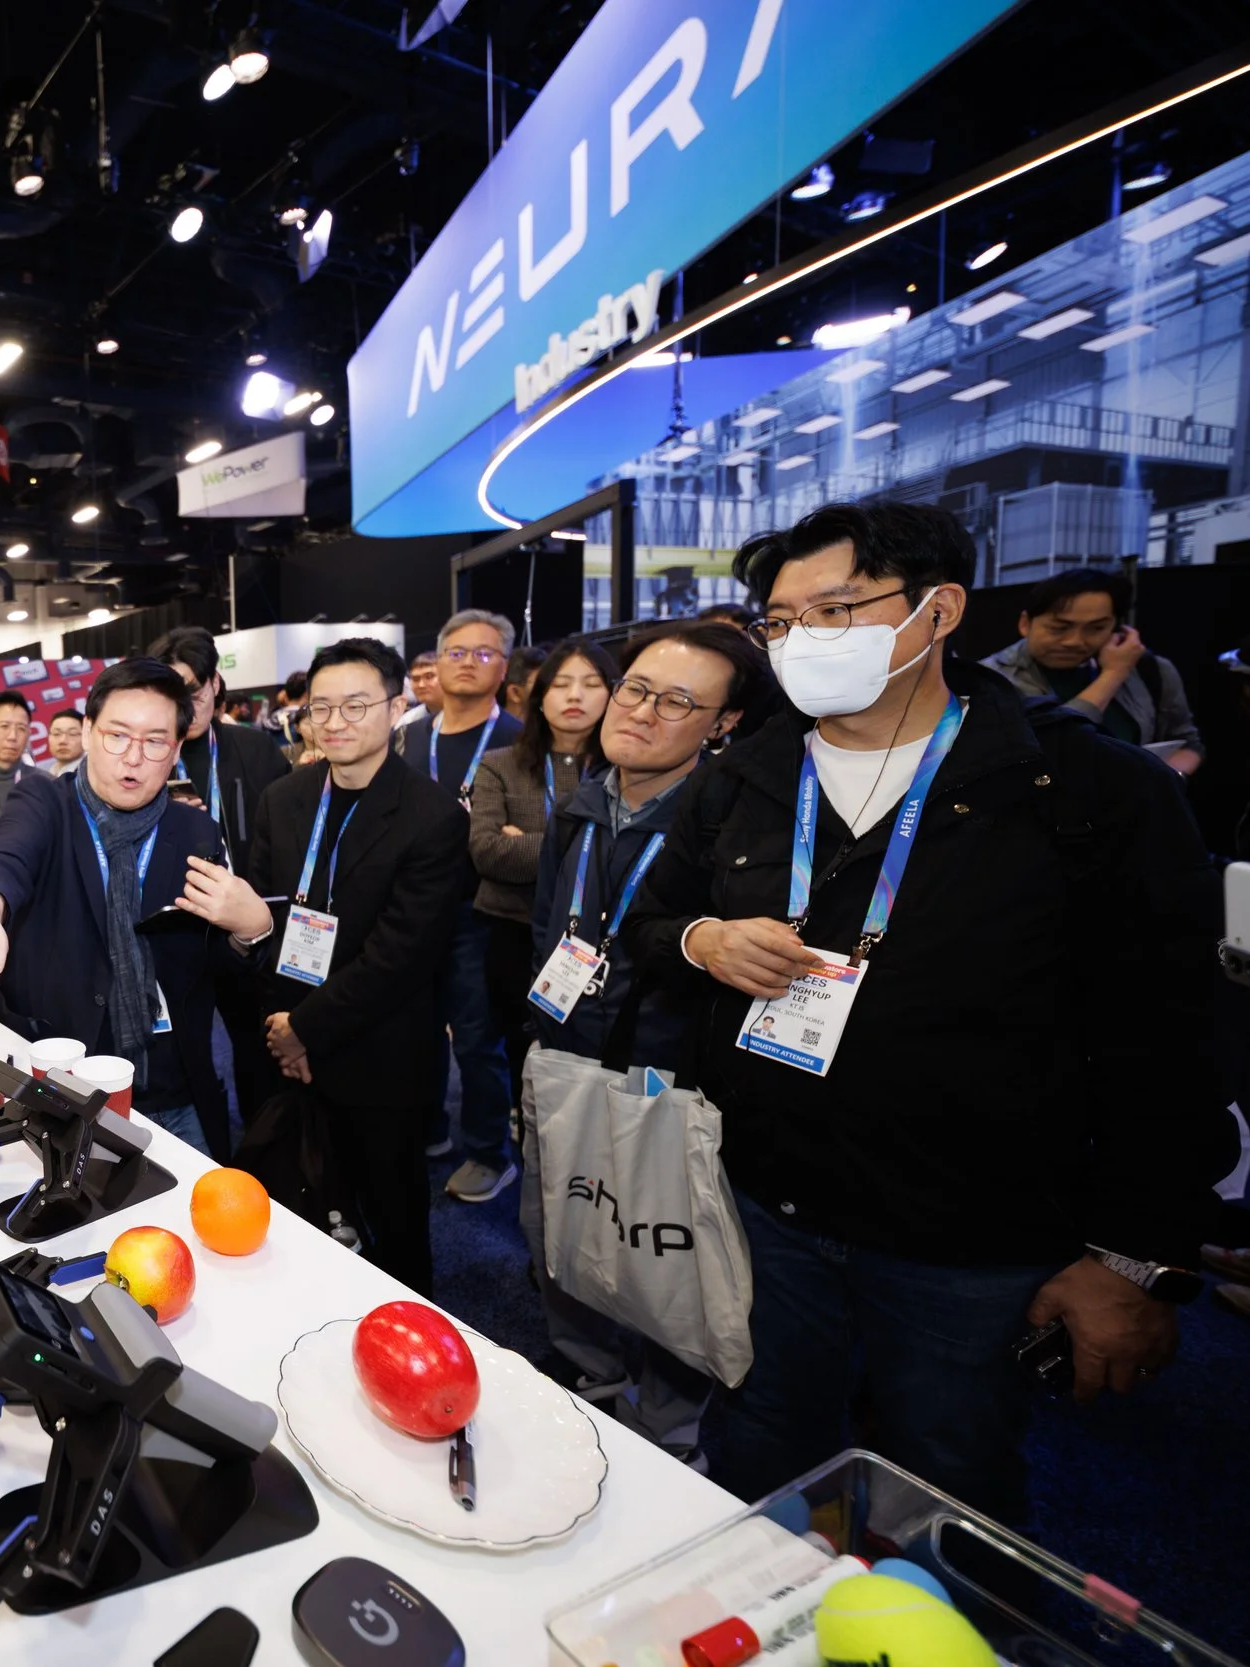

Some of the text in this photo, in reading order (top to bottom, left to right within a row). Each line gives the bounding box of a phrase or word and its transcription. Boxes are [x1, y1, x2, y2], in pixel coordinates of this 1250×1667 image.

[407, 0, 784, 418] NEUR
[515, 269, 664, 413] Industry
[802, 800, 812, 824] Honda
[899, 799, 920, 838] AFEELA
[803, 975, 828, 988] CES
[792, 994, 809, 1005] LEE
[780, 1050, 815, 1066] ATTENDEE
[76, 1152, 85, 1175] DAS
[91, 1488, 113, 1536] DAS
